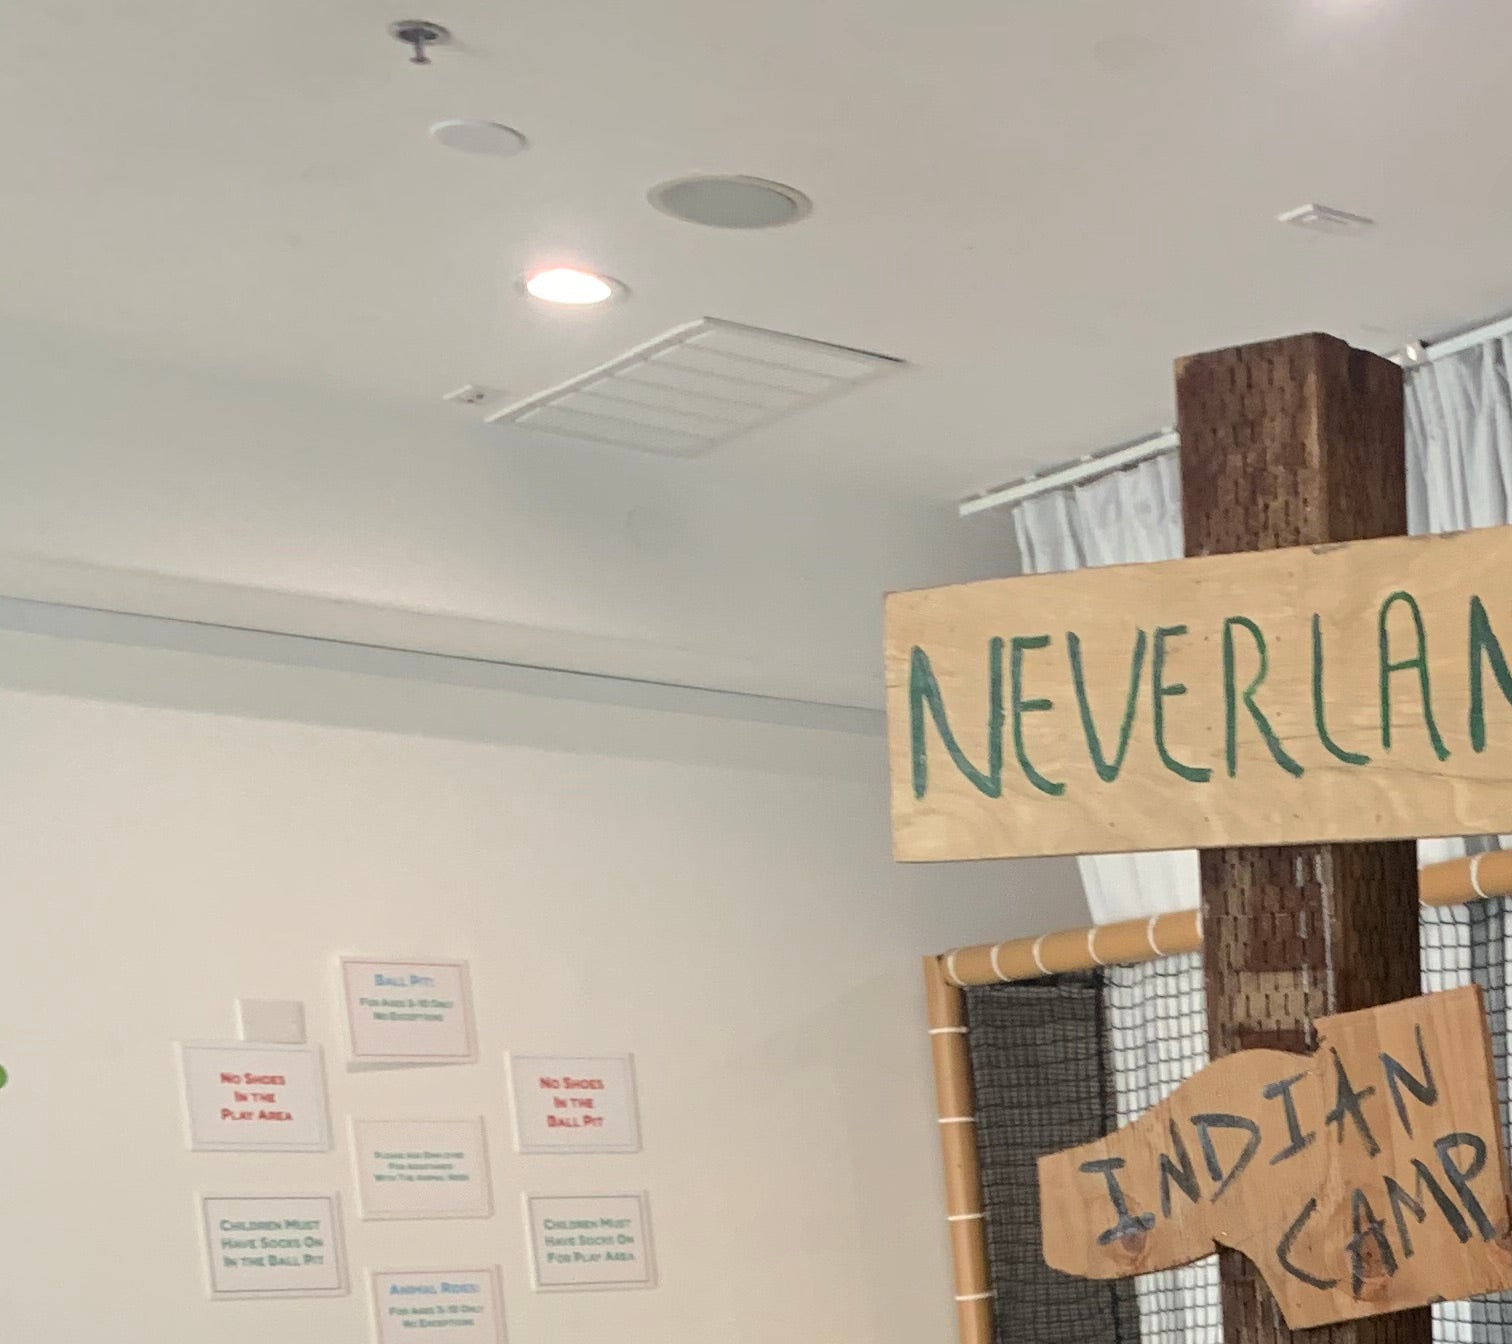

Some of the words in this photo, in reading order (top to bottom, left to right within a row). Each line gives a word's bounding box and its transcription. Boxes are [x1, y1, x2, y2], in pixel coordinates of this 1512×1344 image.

[220, 1072, 242, 1084] NO
[244, 1072, 286, 1086] SHOES
[540, 1077, 560, 1089] NO
[562, 1076, 604, 1089] SHOES
[234, 1091, 248, 1102] IN
[250, 1093, 276, 1103] THE
[553, 1096, 567, 1108] IN
[569, 1098, 593, 1109] THE
[220, 1108, 254, 1120] PLAY
[258, 1110, 294, 1121] AREA
[547, 1114, 580, 1127] BALL
[582, 1114, 603, 1127] PIT
[1080, 1023, 1439, 1246] INDIAN
[1277, 1132, 1499, 1300] CAMP
